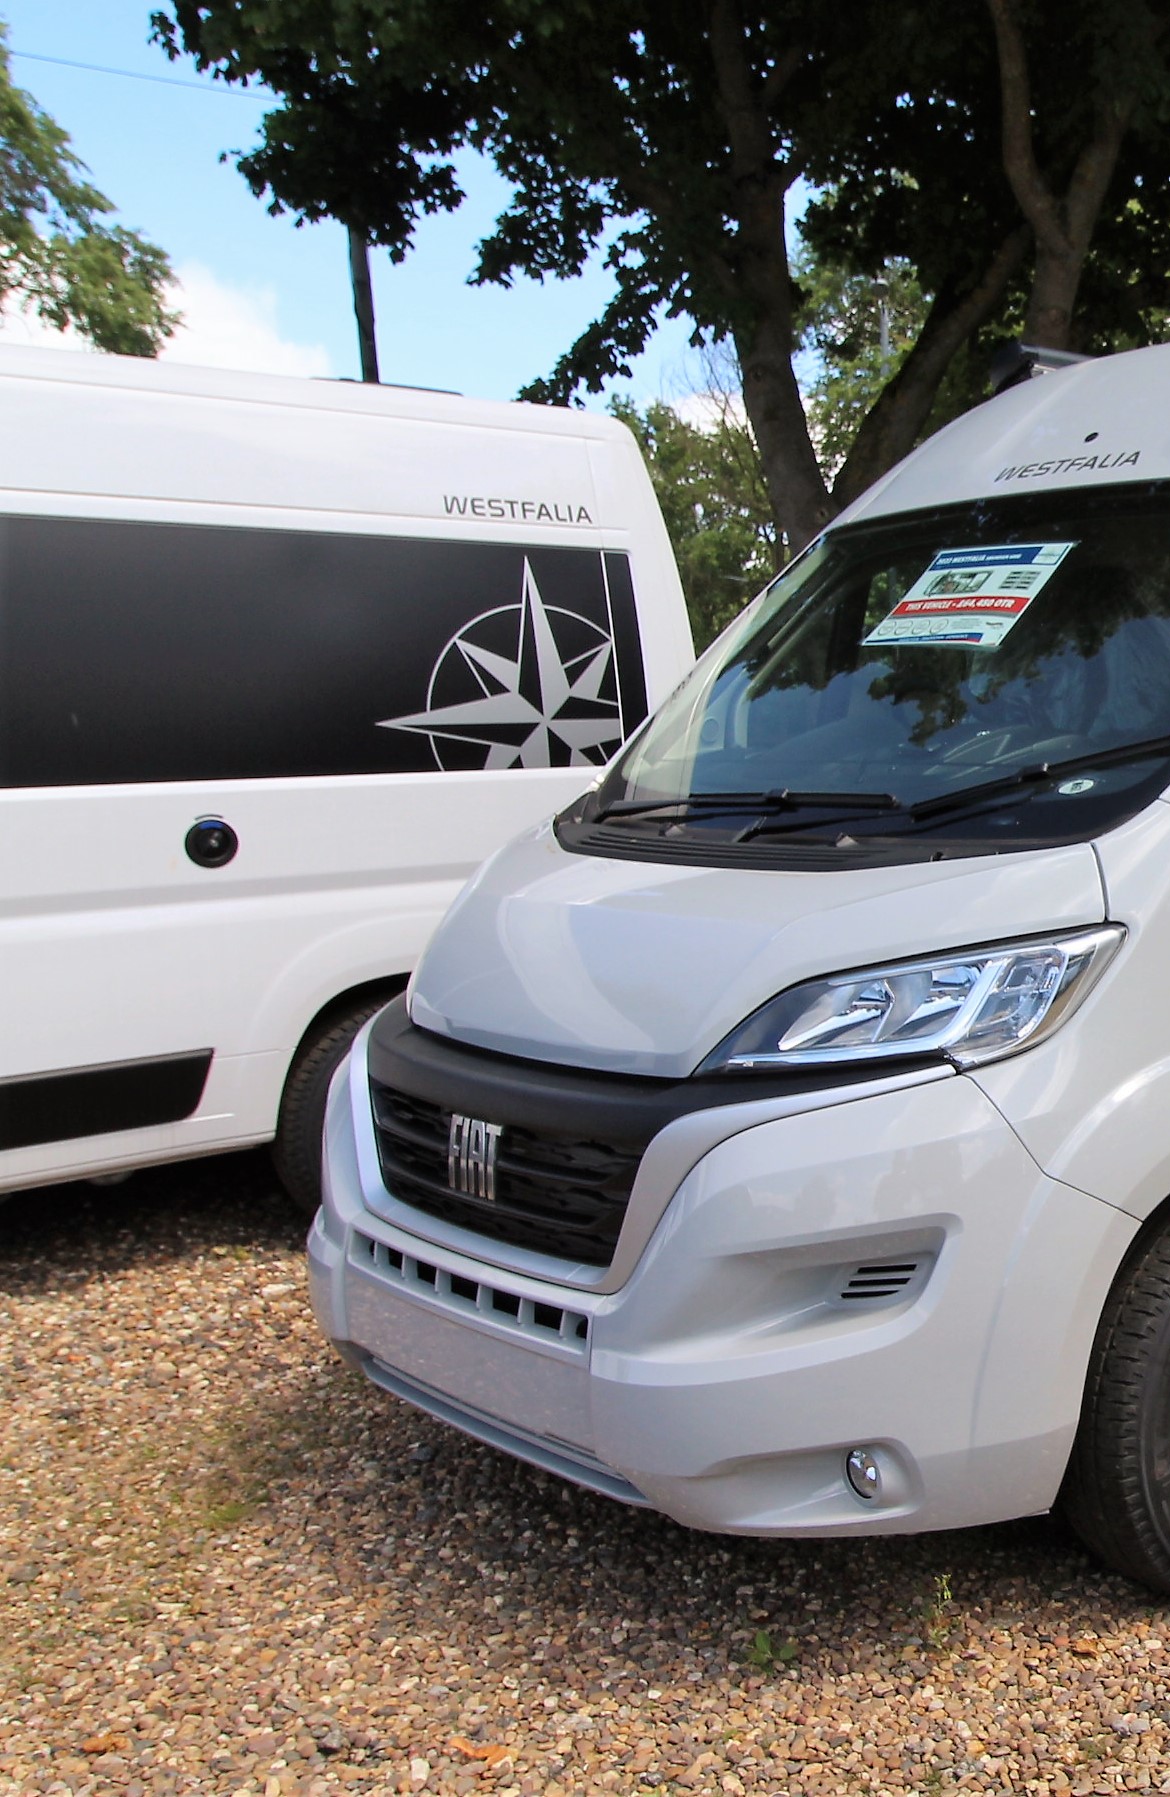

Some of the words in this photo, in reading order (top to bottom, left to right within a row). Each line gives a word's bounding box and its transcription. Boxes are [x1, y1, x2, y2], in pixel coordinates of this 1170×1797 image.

[993, 450, 1142, 483] WESTFALIA
[443, 494, 593, 524] WESTFALIA
[922, 600, 953, 610] VEHICLE
[447, 1113, 503, 1201] FIAT
